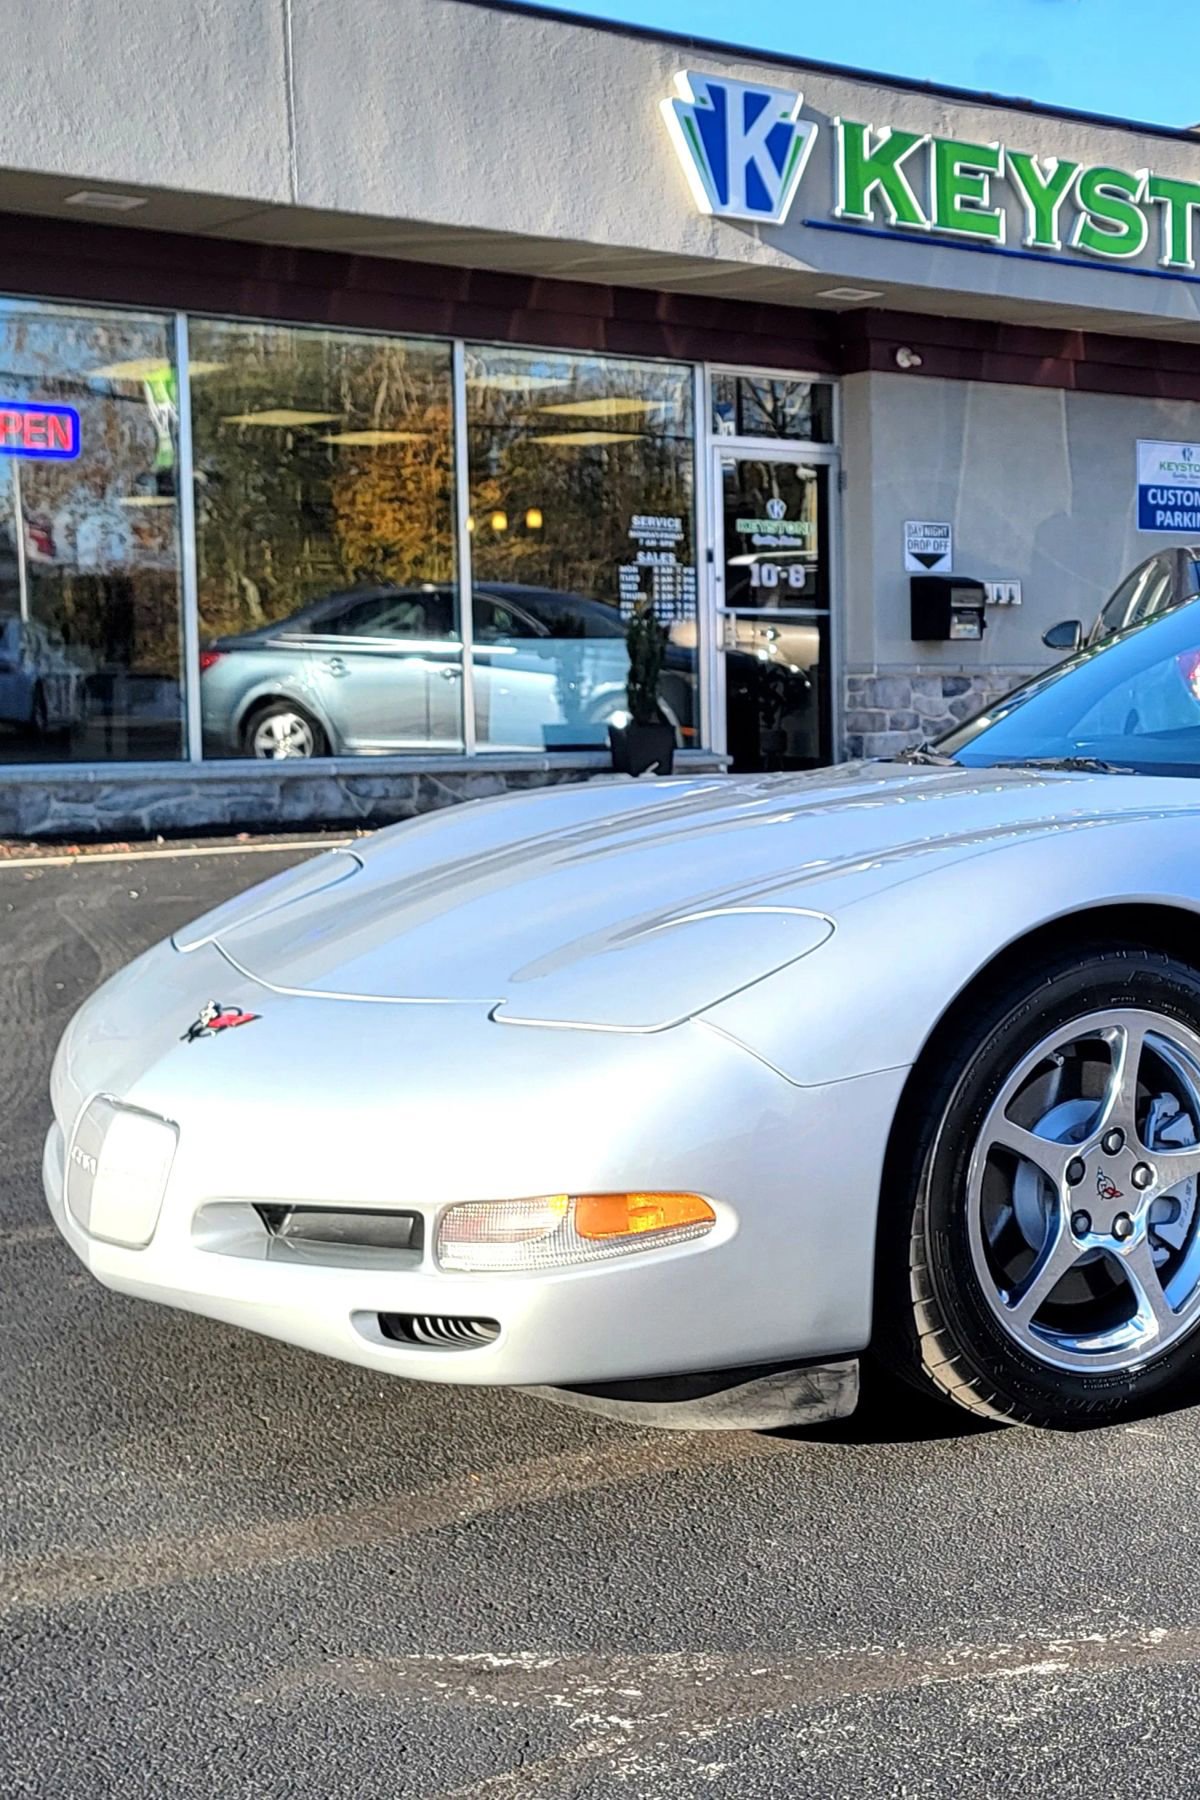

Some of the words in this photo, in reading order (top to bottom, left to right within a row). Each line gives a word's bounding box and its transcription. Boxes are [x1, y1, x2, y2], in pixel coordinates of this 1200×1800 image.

[0, 410, 73, 452] PEN
[631, 514, 682, 531] SERVICE
[923, 525, 949, 538] NIGHT
[907, 539, 931, 550] DROP
[932, 540, 949, 551] OFF
[637, 551, 677, 563] SALES
